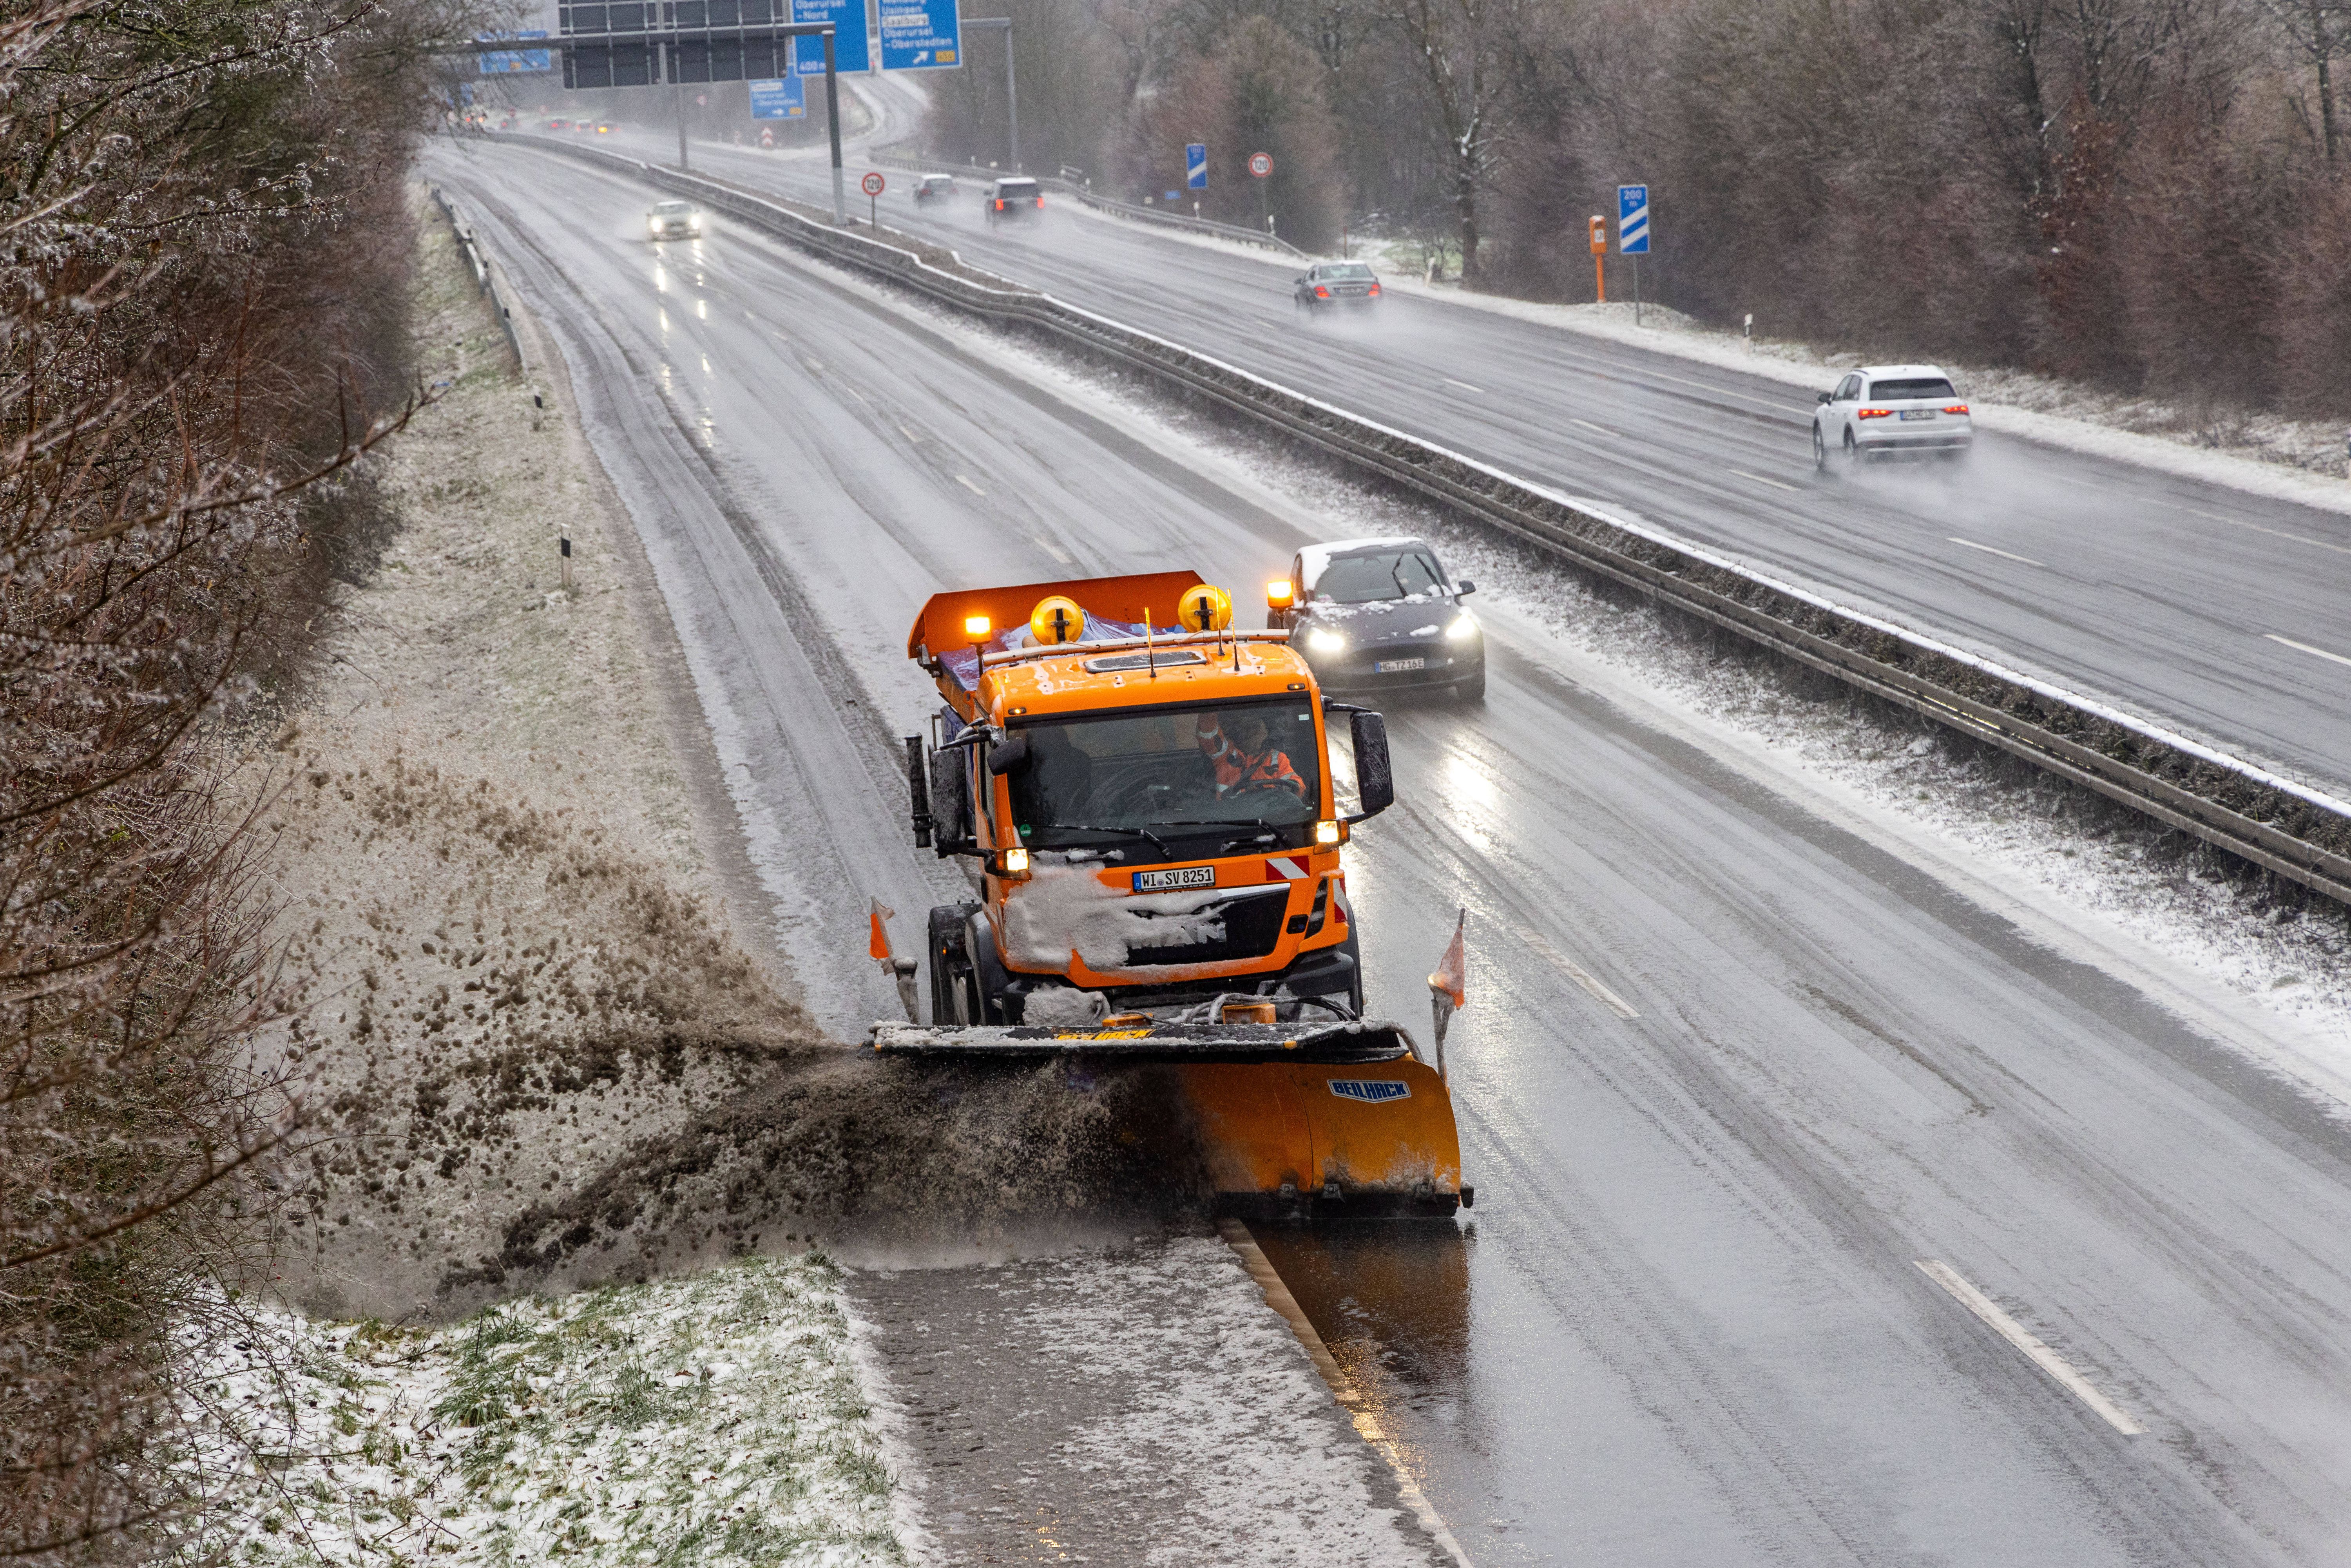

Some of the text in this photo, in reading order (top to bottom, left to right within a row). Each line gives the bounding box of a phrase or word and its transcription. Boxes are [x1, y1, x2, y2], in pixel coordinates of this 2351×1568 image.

[1254, 159, 1267, 170] 120
[867, 179, 880, 189] 120
[1624, 189, 1642, 200] 200
[1379, 663, 1391, 671] HG
[1142, 869, 1212, 887] WI SV 8251
[1332, 1082, 1406, 1099] BEILHACK
